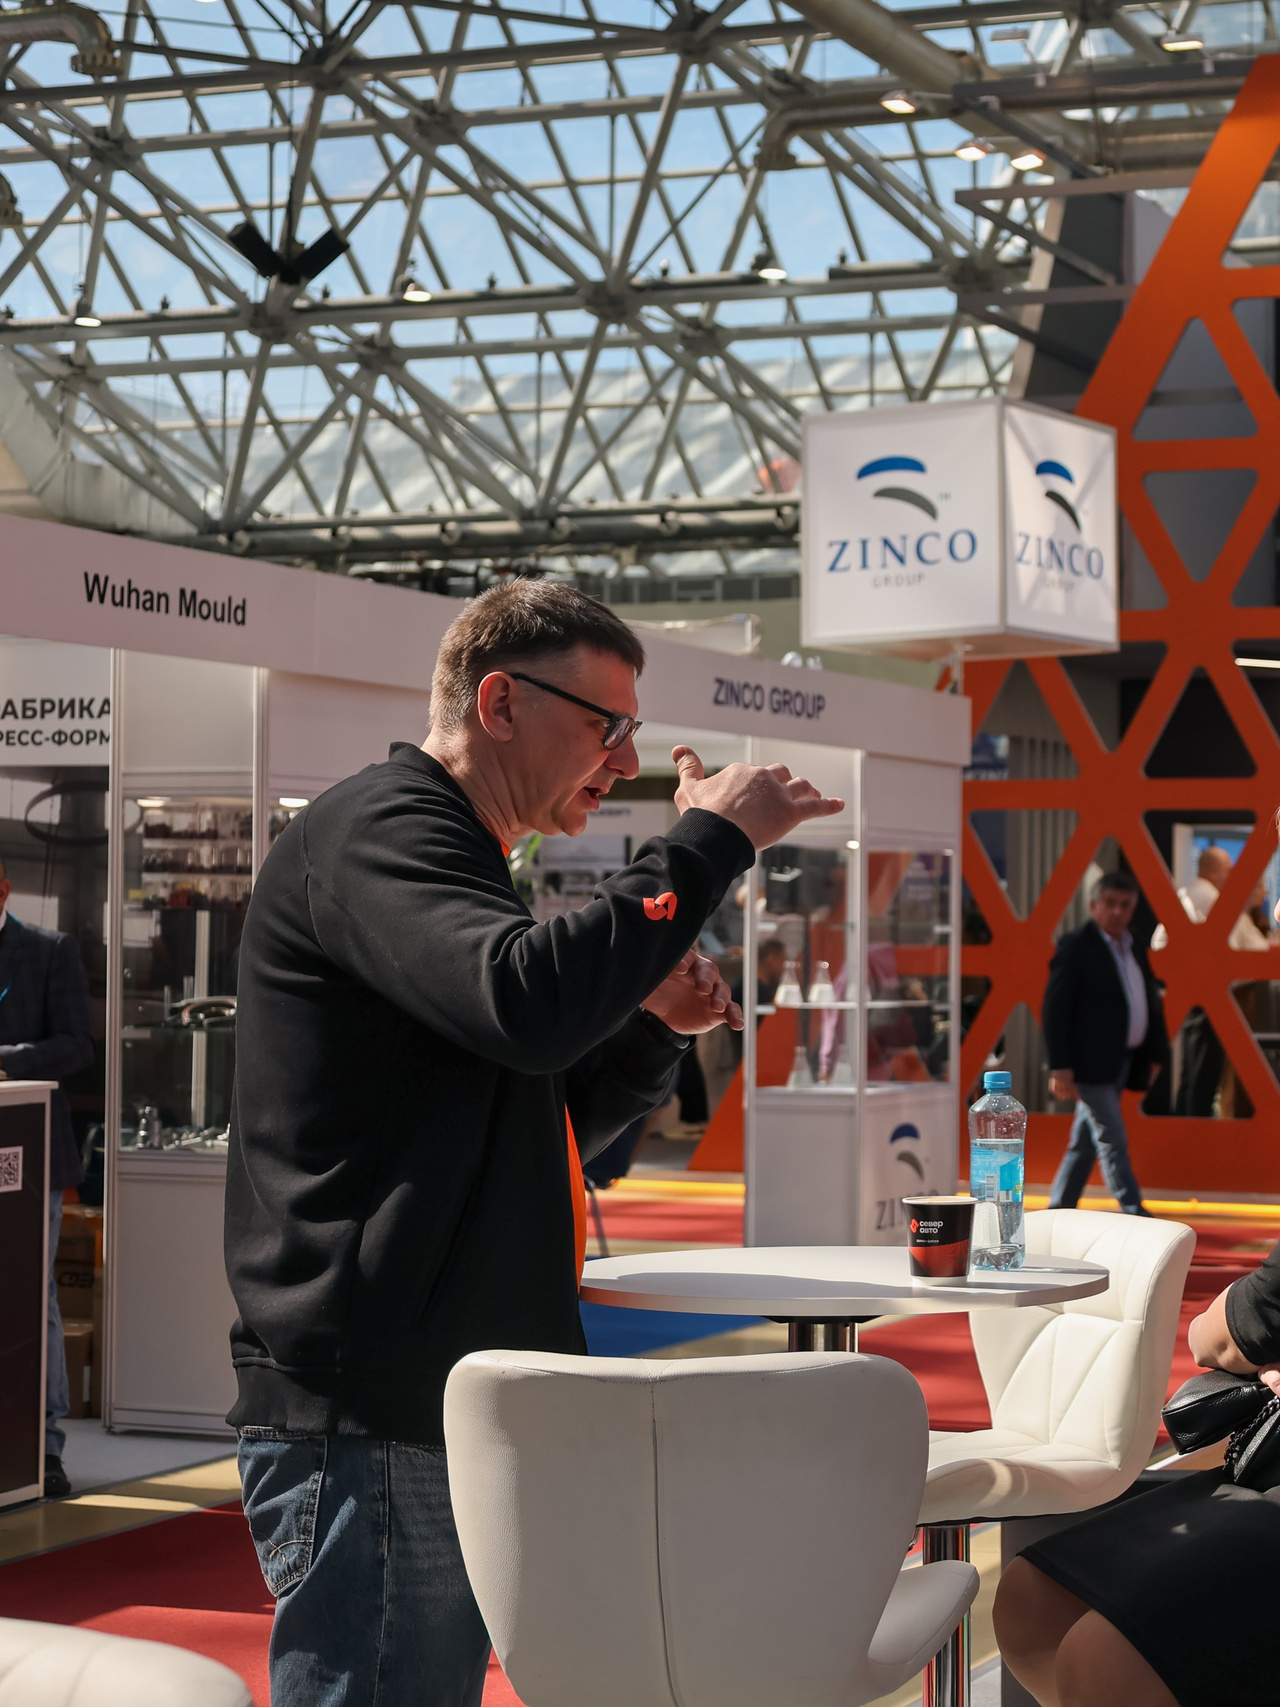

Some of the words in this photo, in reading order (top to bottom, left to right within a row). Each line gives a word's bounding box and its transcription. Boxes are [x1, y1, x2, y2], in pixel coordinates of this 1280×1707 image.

[827, 529, 977, 573] ZINCO
[1016, 531, 1104, 580] ZINCO
[84, 571, 169, 615] Wuhan
[178, 587, 246, 626] Mould
[872, 573, 925, 589] GROUP
[0, 697, 110, 719] АБРИКА
[713, 677, 765, 711] ZINCO
[770, 687, 826, 719] GROUP
